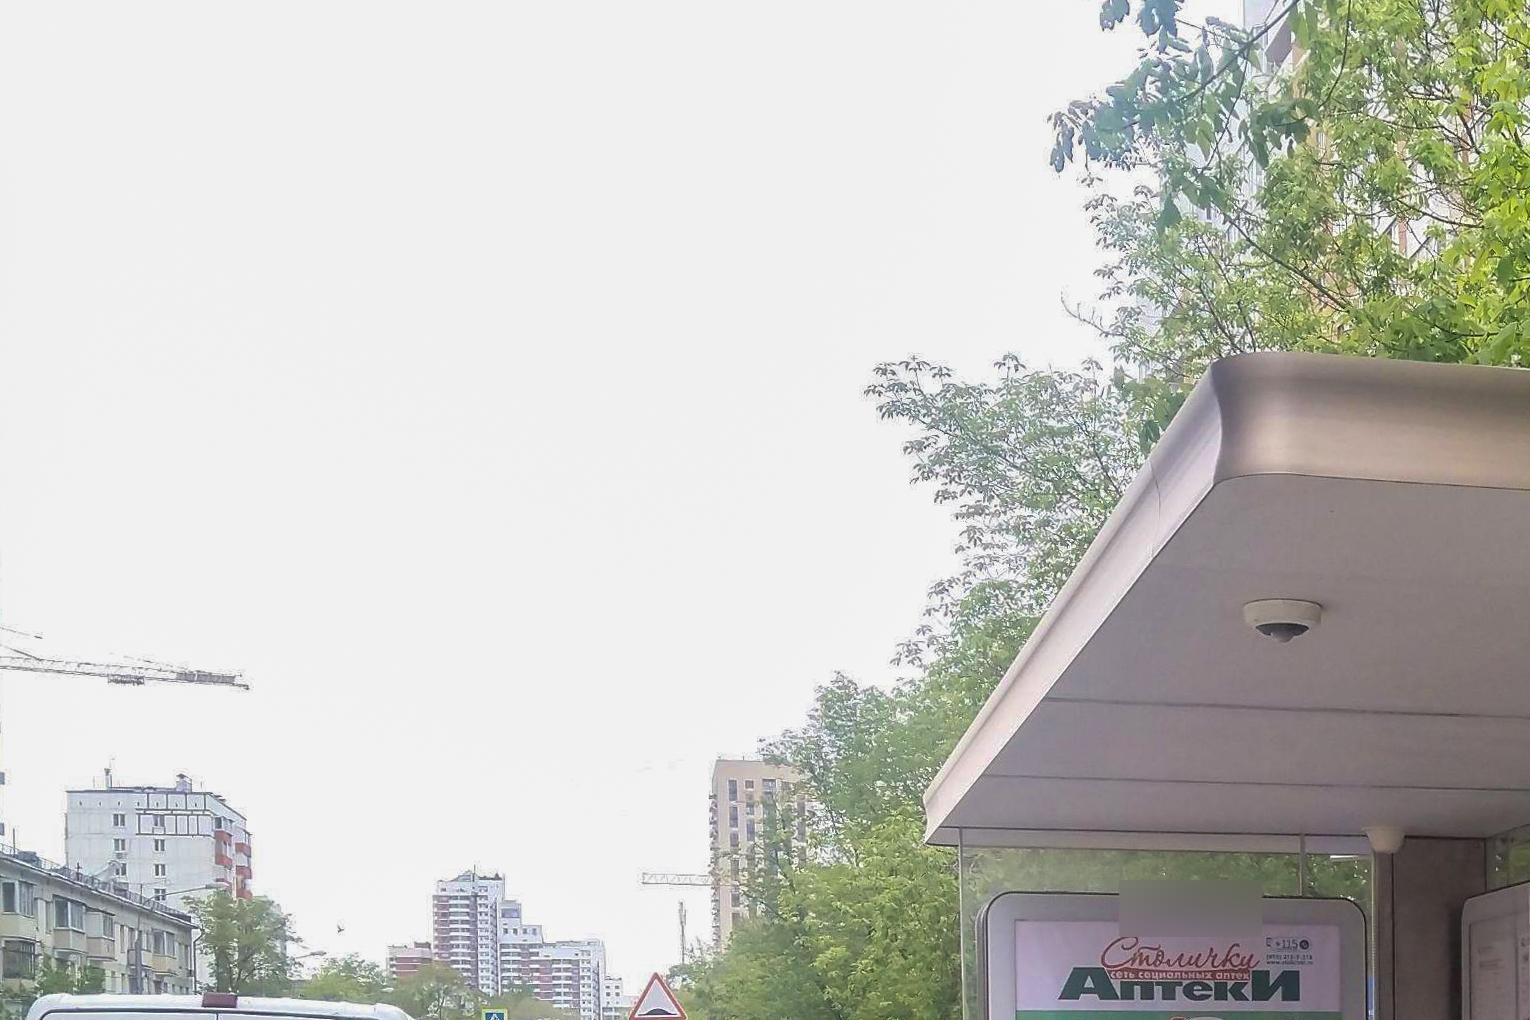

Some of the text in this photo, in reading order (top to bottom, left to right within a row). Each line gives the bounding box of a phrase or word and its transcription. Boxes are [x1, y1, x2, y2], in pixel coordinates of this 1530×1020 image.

[1101, 937, 1260, 969] Столички
[1110, 969, 1250, 981] сеть социальных аптек
